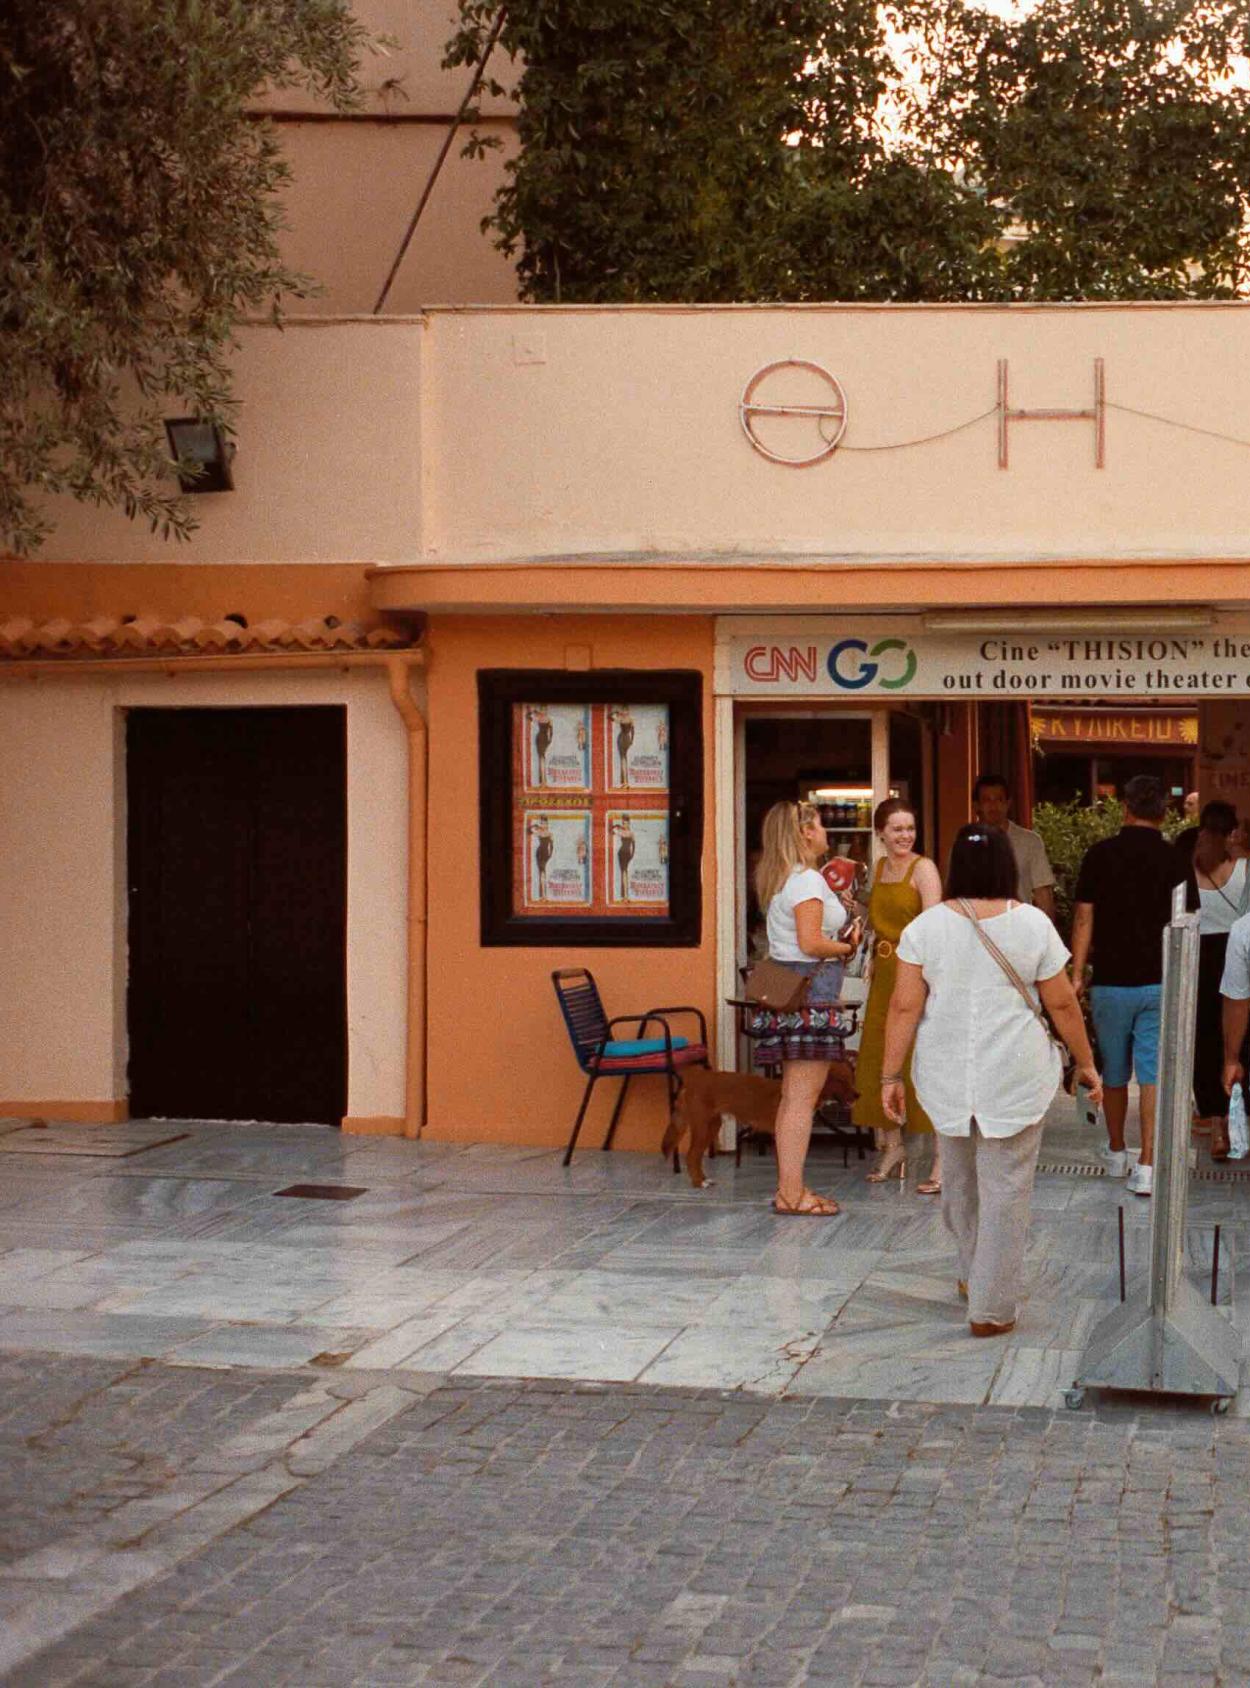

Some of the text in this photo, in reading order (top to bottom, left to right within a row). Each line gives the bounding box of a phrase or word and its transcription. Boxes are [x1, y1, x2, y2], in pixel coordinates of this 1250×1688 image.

[979, 640, 1040, 661] Cine
[743, 638, 918, 690] CNN GO
[942, 672, 984, 690] out
[992, 669, 1053, 690] door
[1060, 669, 1136, 689] movie
[1145, 669, 1238, 689] theater
